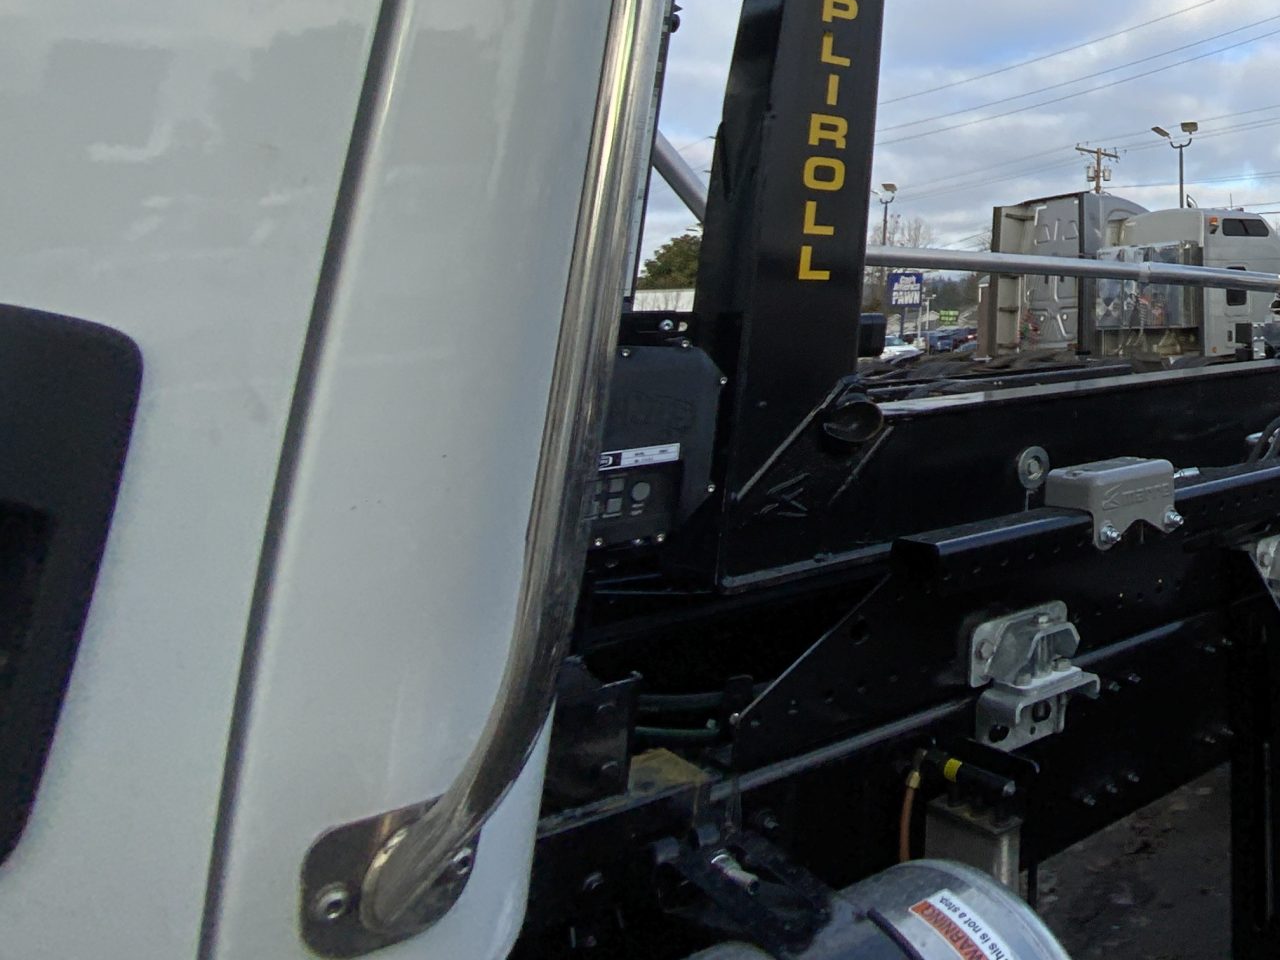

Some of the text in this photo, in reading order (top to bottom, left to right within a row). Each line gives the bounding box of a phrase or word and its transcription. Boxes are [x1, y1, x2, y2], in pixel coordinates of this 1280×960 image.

[892, 290, 920, 305] PAWN
[963, 918, 982, 933] not
[979, 933, 991, 944] is
[988, 942, 1009, 960] his
